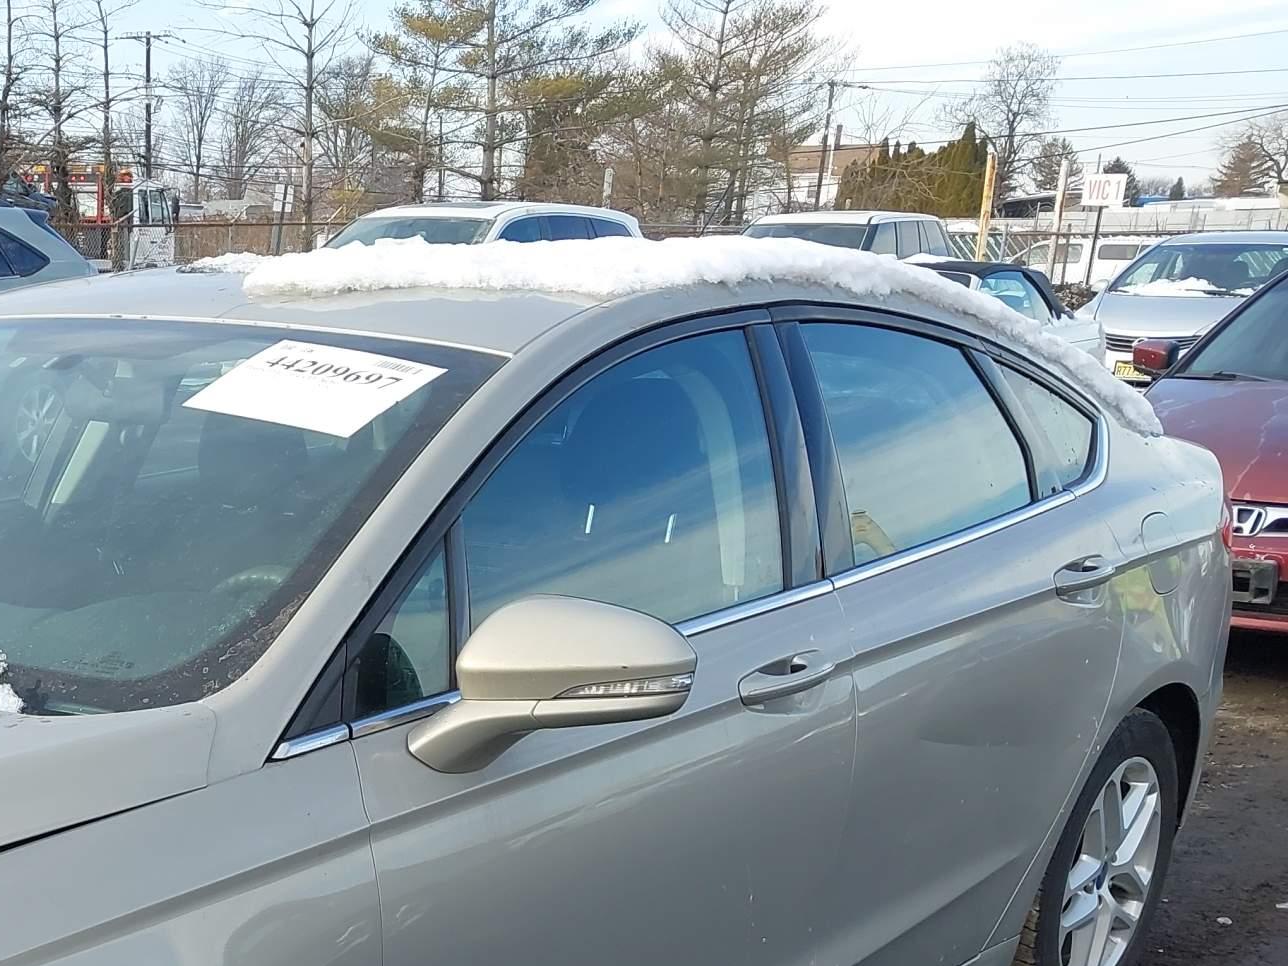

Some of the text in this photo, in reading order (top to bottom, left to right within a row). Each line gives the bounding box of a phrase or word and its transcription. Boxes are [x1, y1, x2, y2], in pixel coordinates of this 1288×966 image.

[1088, 180, 1122, 200] VIC 1
[265, 355, 403, 389] 44209697
